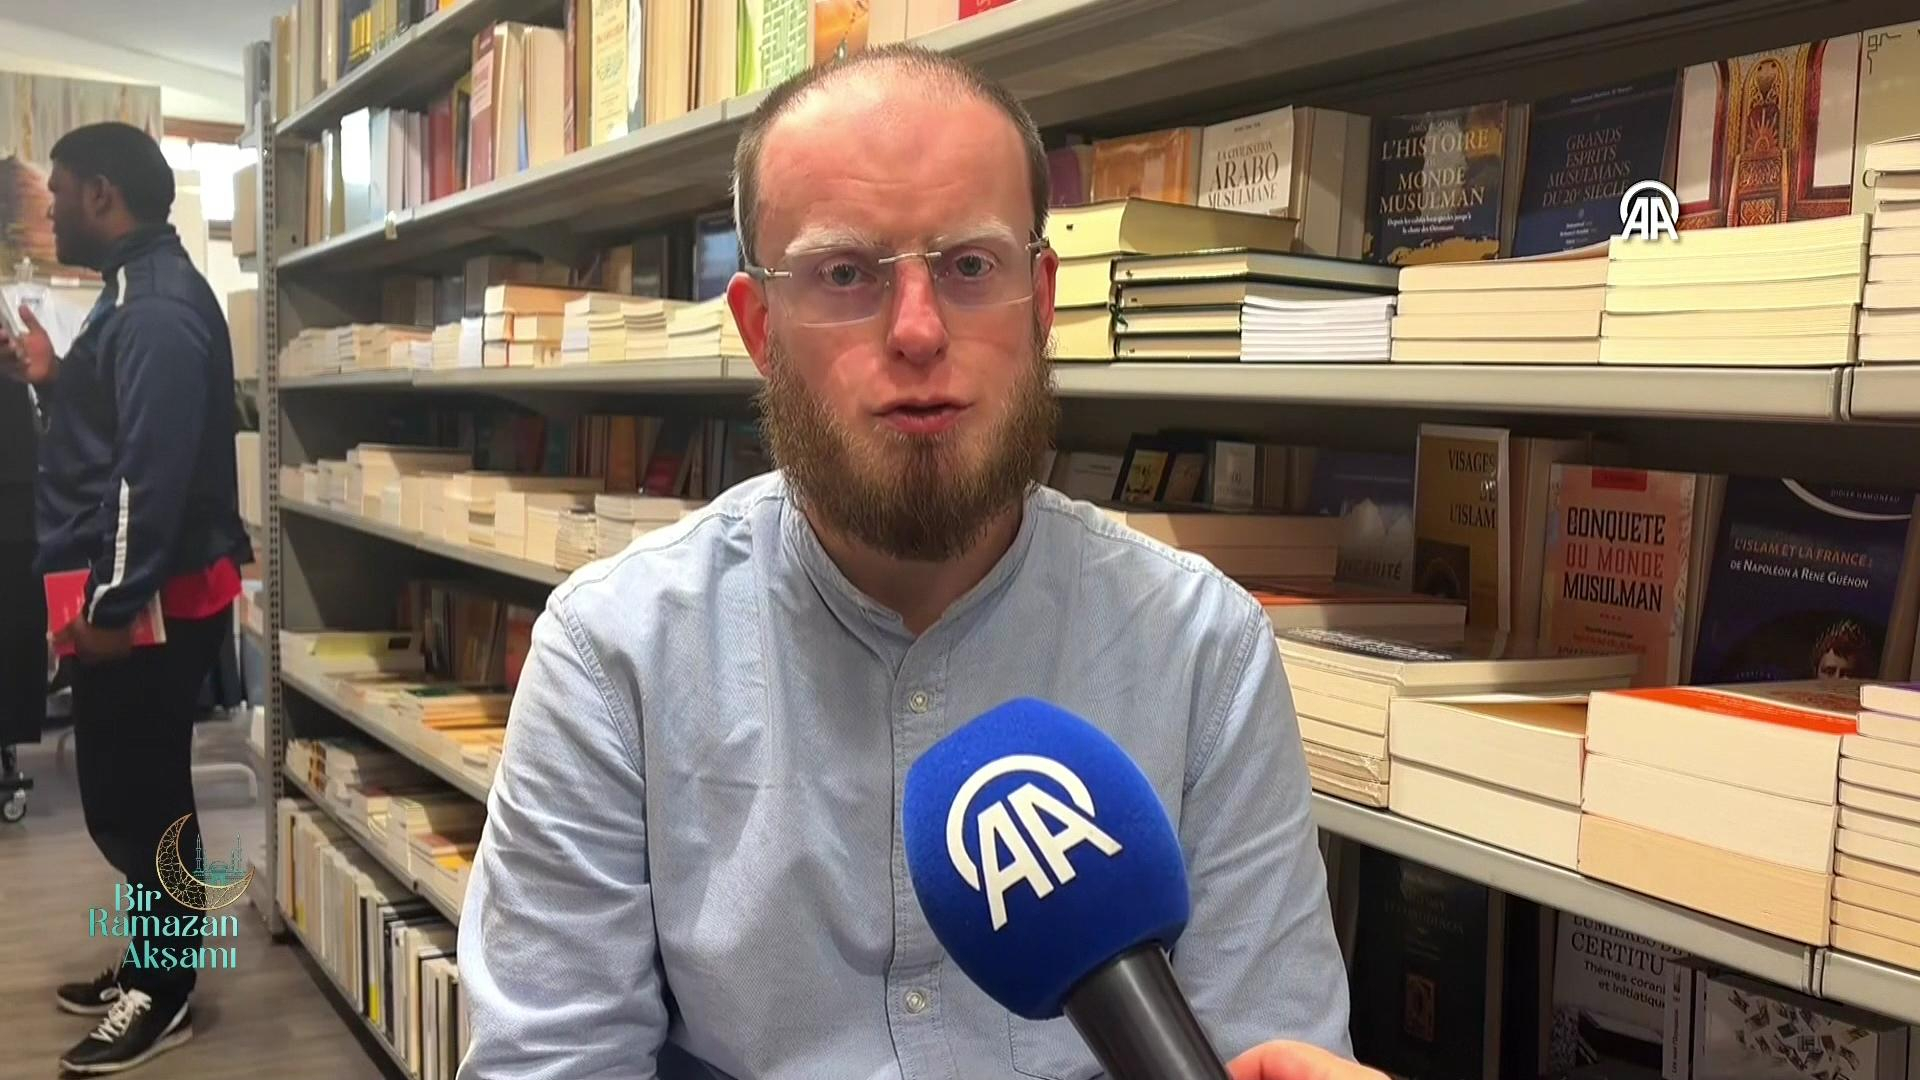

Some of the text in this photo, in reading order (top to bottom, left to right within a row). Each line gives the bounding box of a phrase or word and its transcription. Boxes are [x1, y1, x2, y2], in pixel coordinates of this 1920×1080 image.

[1382, 128, 1488, 160] L'HISTOIRE
[1566, 128, 1622, 150] GRANDS
[1566, 145, 1616, 168] ESPRITS
[1210, 152, 1279, 191] ARABO
[1398, 167, 1466, 191] MONDE
[1547, 161, 1632, 189] MUSULMANS
[1208, 183, 1277, 208] MUSULMANE
[1379, 186, 1485, 214] MUSULMAN
[1448, 448, 1495, 473] VISAGES
[1449, 503, 1496, 529] L'ISLAM
[1567, 506, 1666, 546] CONQUETE
[1598, 547, 1664, 579] MONDE
[1734, 538, 1778, 557] L'ISLAM
[1781, 543, 1795, 559] ET
[1797, 545, 1814, 562] LA
[1563, 572, 1662, 613] MUSULMAN
[977, 782, 1123, 931] AA
[1598, 980, 1610, 992] et
